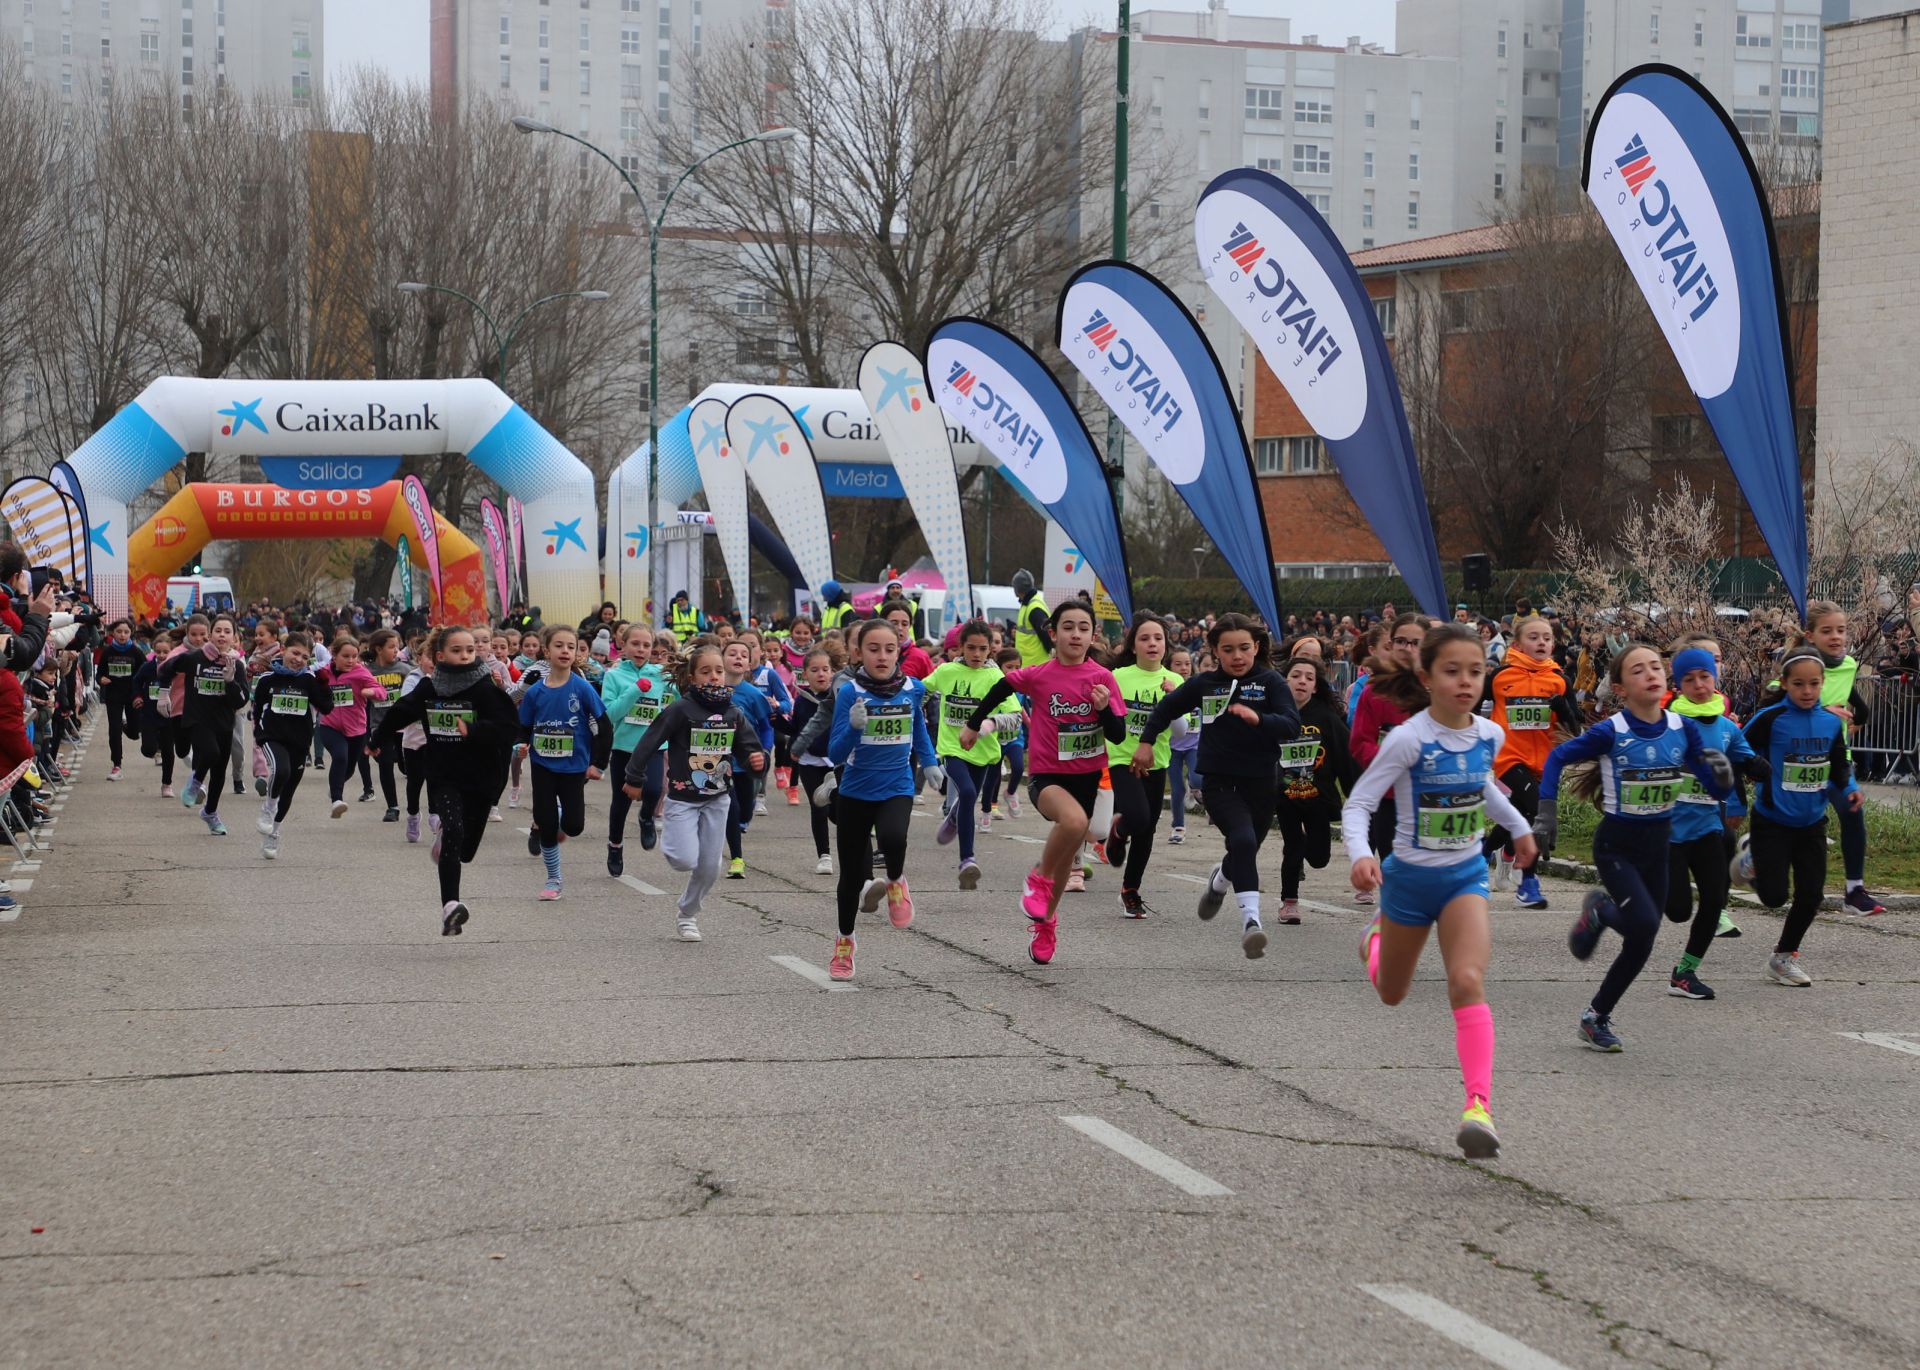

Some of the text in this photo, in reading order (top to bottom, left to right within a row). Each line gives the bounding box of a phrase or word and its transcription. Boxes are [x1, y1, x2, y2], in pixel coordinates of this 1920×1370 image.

[275, 402, 440, 432] CaixaBank
[299, 462, 363, 480] Salida
[836, 468, 888, 488] Meta
[217, 488, 372, 507] BURGOS
[205, 681, 222, 690] 471
[281, 697, 299, 708] 461
[950, 706, 971, 720] 505
[1132, 713, 1148, 726] 49
[1516, 708, 1542, 722] 506
[874, 719, 903, 735] 483
[542, 737, 563, 750] 481
[704, 732, 728, 747] 475
[1072, 733, 1098, 751] 420
[1290, 745, 1313, 759] 687
[1798, 767, 1824, 782] 430
[1639, 784, 1672, 804] 476
[1441, 811, 1478, 836] 478
